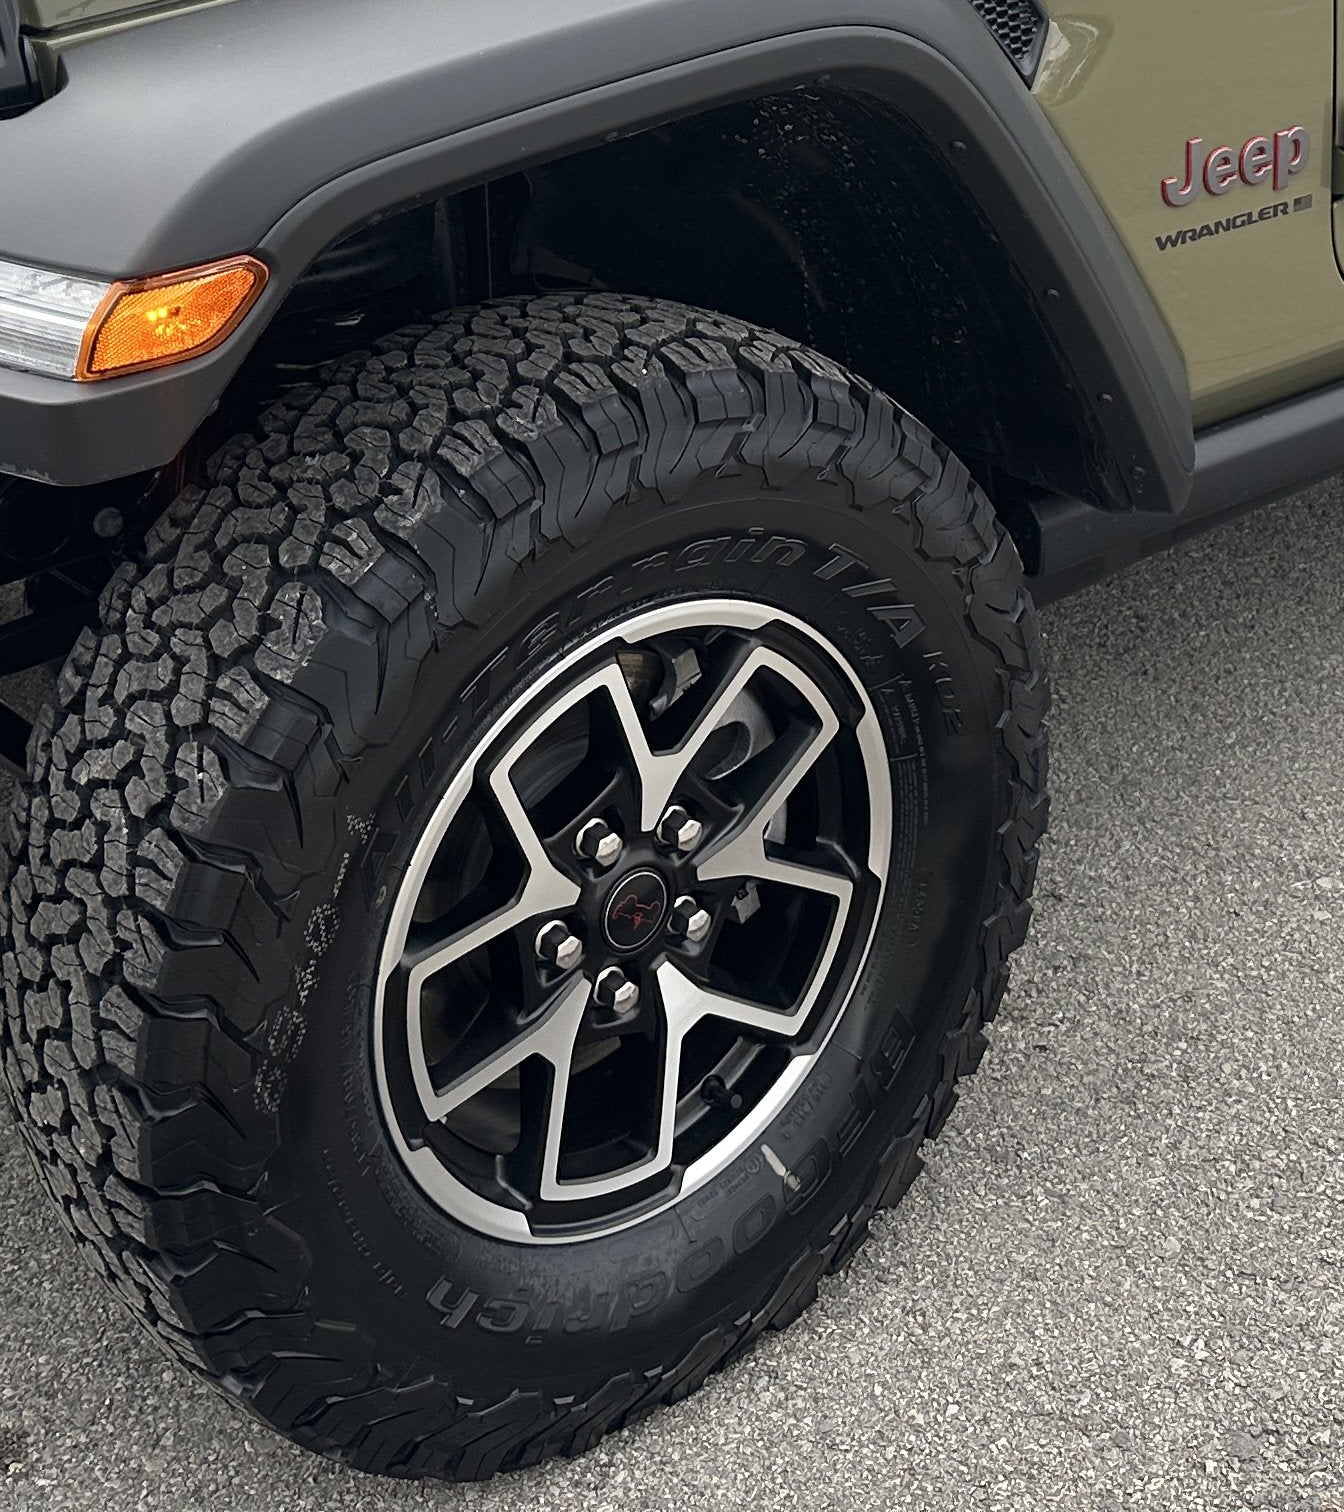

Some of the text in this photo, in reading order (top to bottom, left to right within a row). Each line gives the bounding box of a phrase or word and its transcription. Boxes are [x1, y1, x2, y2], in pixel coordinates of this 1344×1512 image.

[1160, 125, 1311, 207] Jeep
[1154, 201, 1289, 251] WRANGLER
[423, 1007, 916, 1344] BFGoodrich
